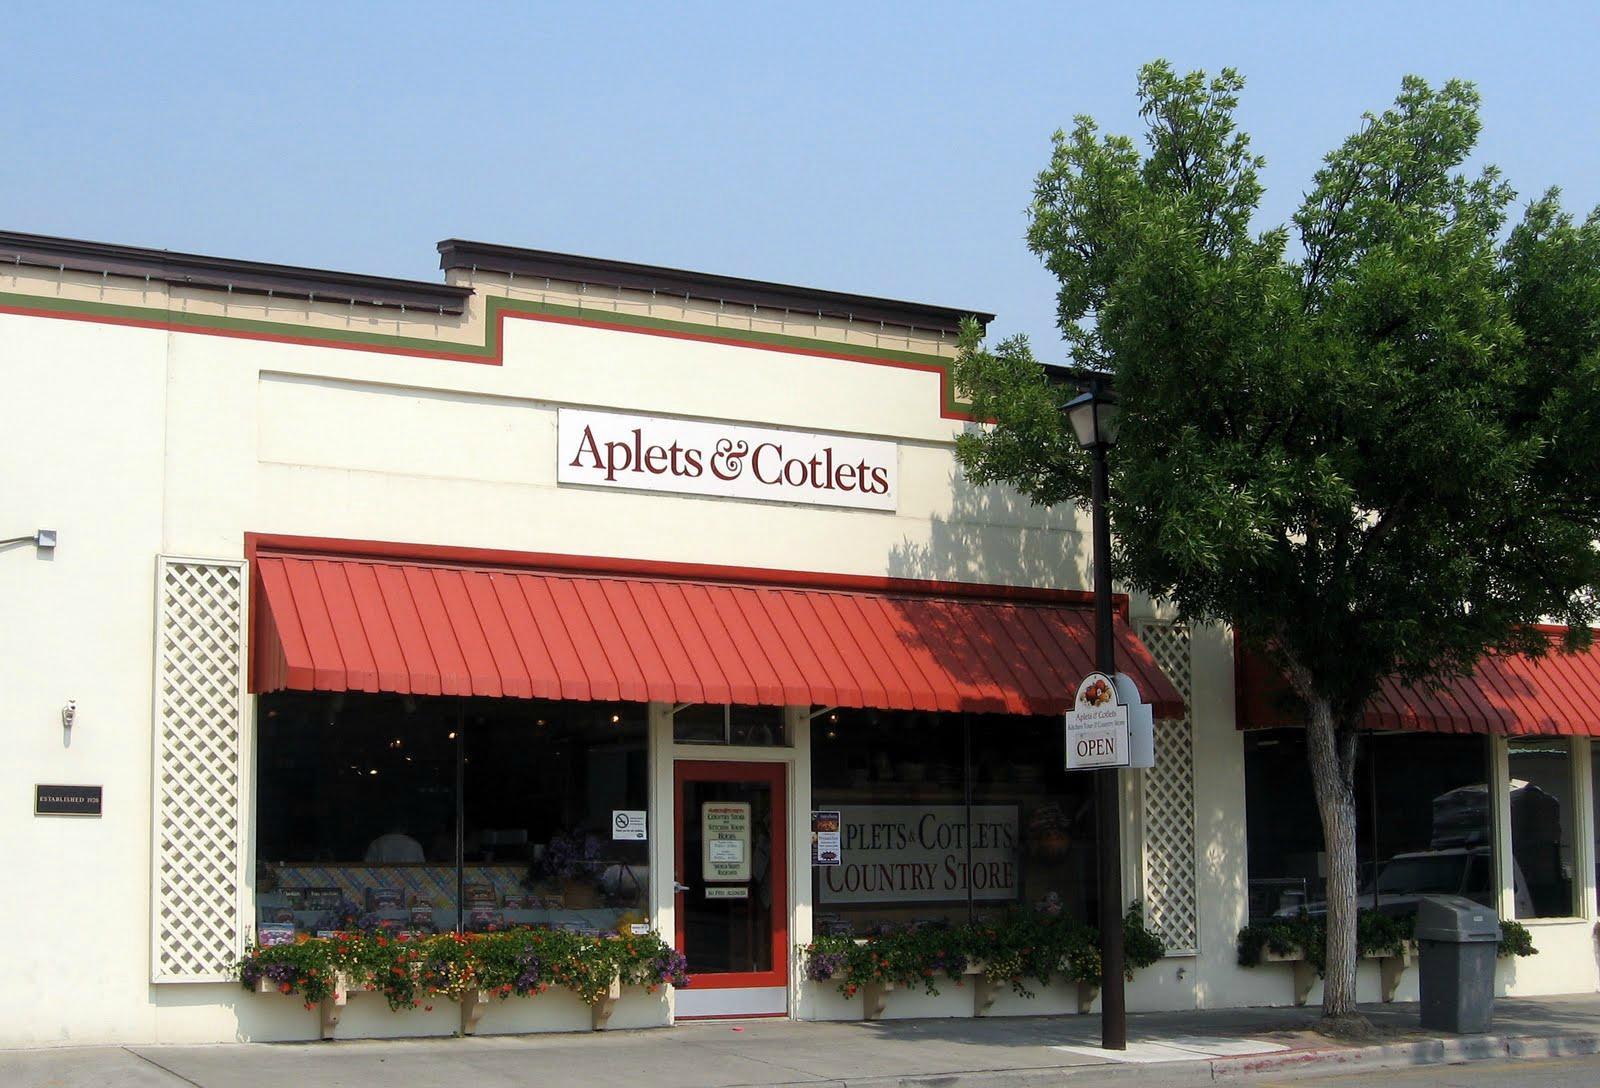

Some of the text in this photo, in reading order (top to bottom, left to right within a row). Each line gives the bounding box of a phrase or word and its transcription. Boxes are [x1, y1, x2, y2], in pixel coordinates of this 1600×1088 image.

[568, 424, 889, 495] Aplets & Cotlets
[1075, 712, 1092, 722] Aplets
[1077, 738, 1114, 757] OPEN
[840, 822, 906, 850] PLETS
[944, 854, 1014, 891] STORE
